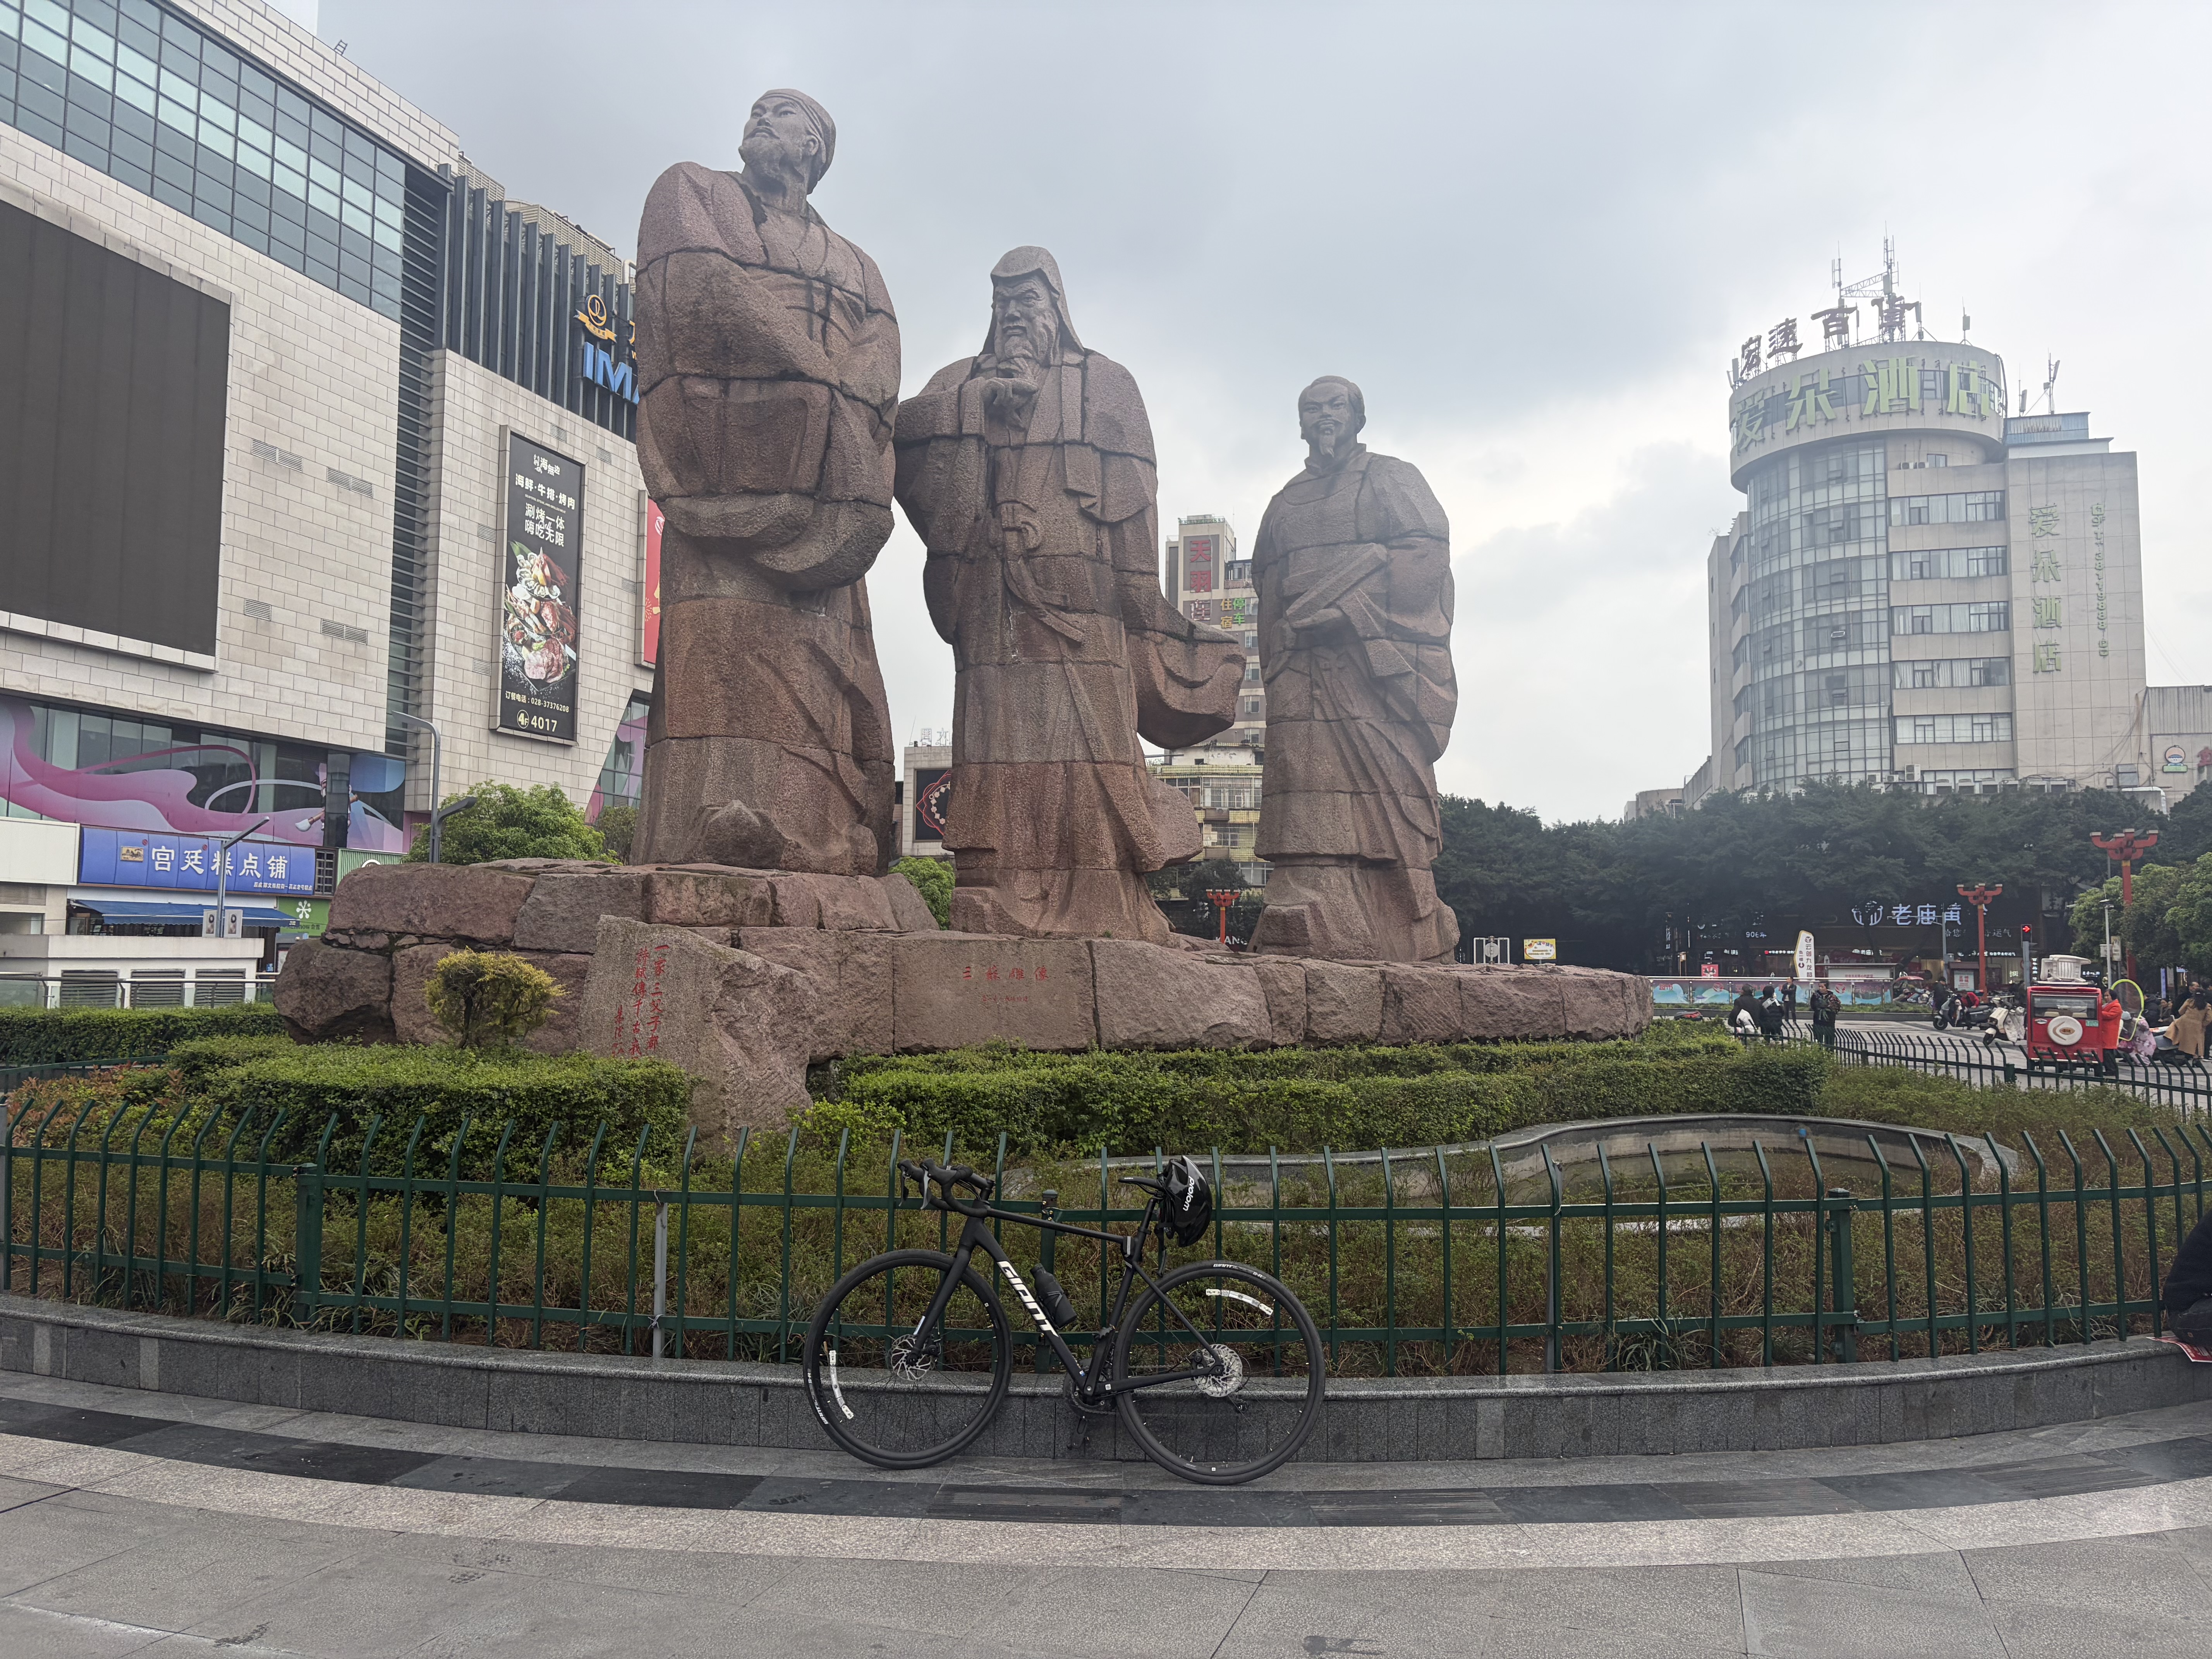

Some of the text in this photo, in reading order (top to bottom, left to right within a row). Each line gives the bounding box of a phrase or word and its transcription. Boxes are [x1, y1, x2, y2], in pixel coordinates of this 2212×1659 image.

[1736, 356, 1990, 449] 爱朵酒店
[525, 503, 565, 531] 涮烤一体
[525, 520, 564, 547] 嗨吃无限
[2030, 504, 2062, 673] 爱朵酒店
[1220, 599, 1233, 629] 住宿
[1233, 598, 1245, 625] 停车
[518, 713, 557, 732] 4F 4017
[152, 845, 288, 879] 宫廷糕点铺
[1892, 903, 1989, 925] 老庙黄
[997, 1261, 1059, 1338] GIANT
